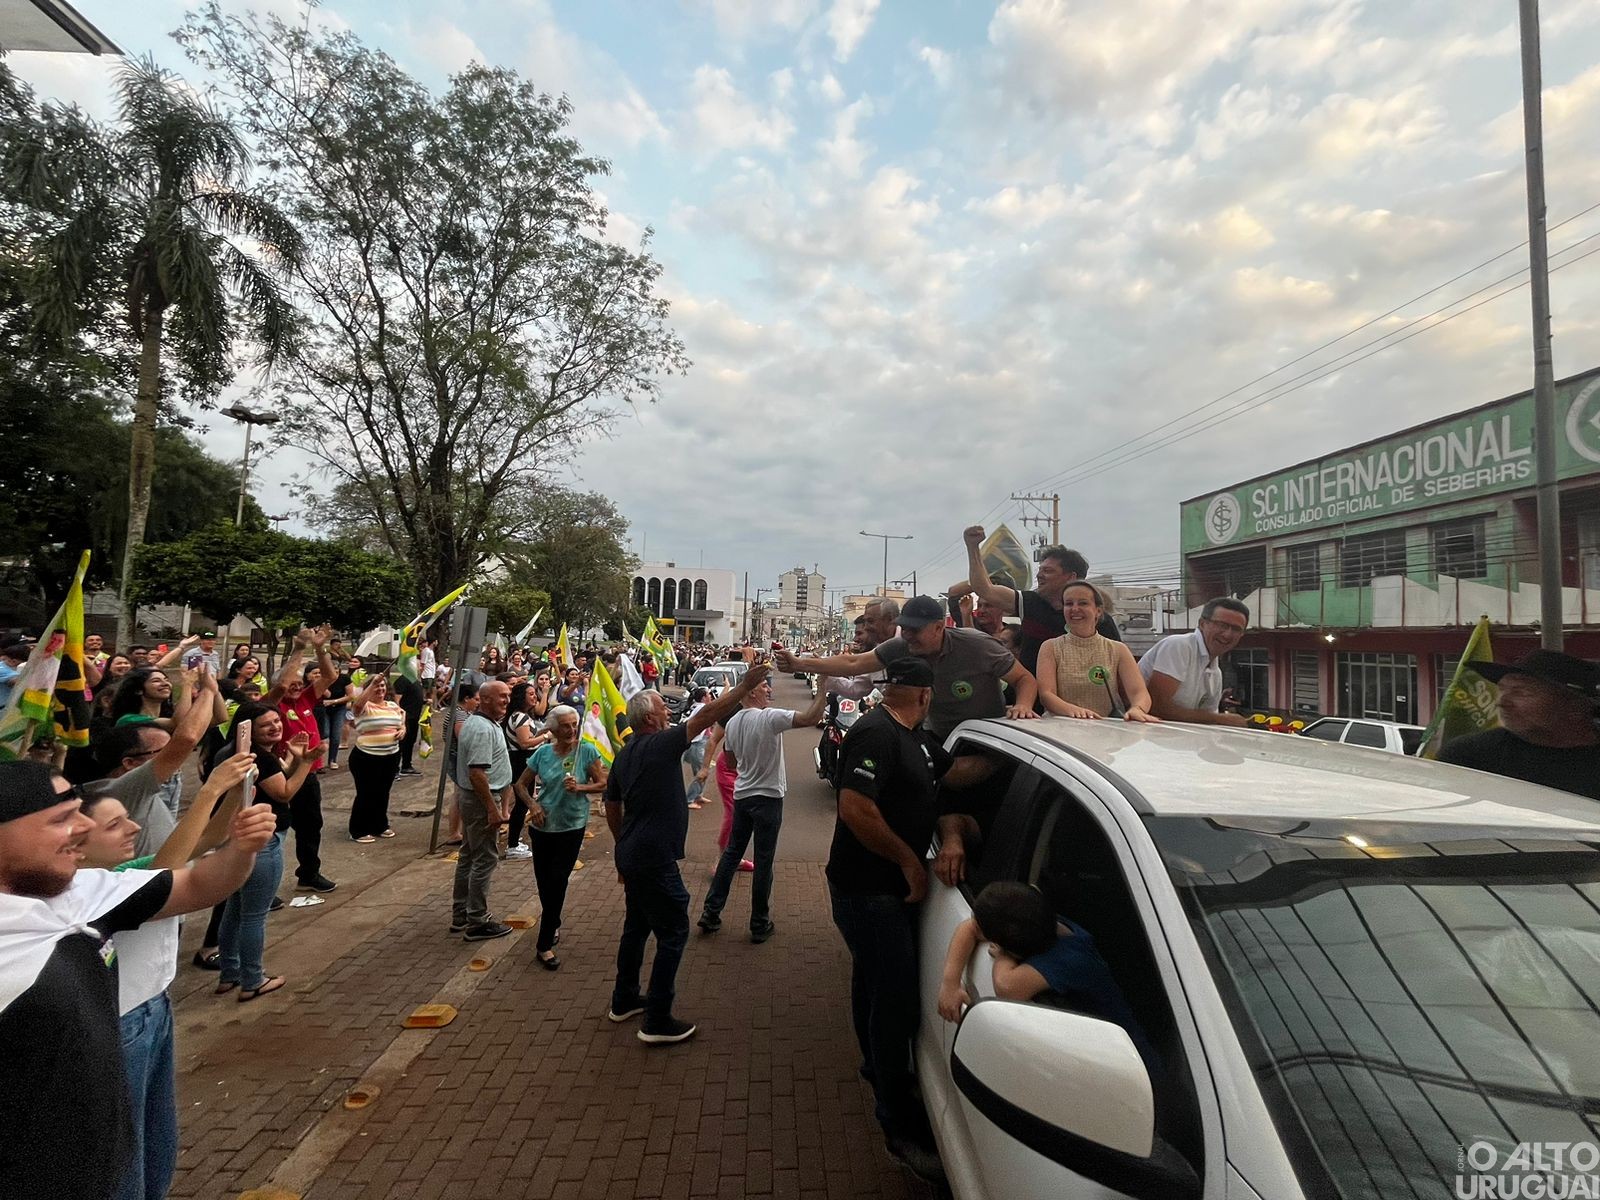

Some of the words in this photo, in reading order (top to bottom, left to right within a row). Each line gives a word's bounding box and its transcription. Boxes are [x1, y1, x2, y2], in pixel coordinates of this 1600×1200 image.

[1255, 507, 1323, 533] CONSULADO
[1327, 494, 1383, 517] OFICIAL
[1391, 485, 1415, 505] DE
[1424, 460, 1530, 497] SEBERI-RS
[1284, 414, 1532, 512] INTERNACIONAL
[840, 700, 854, 711] 15
